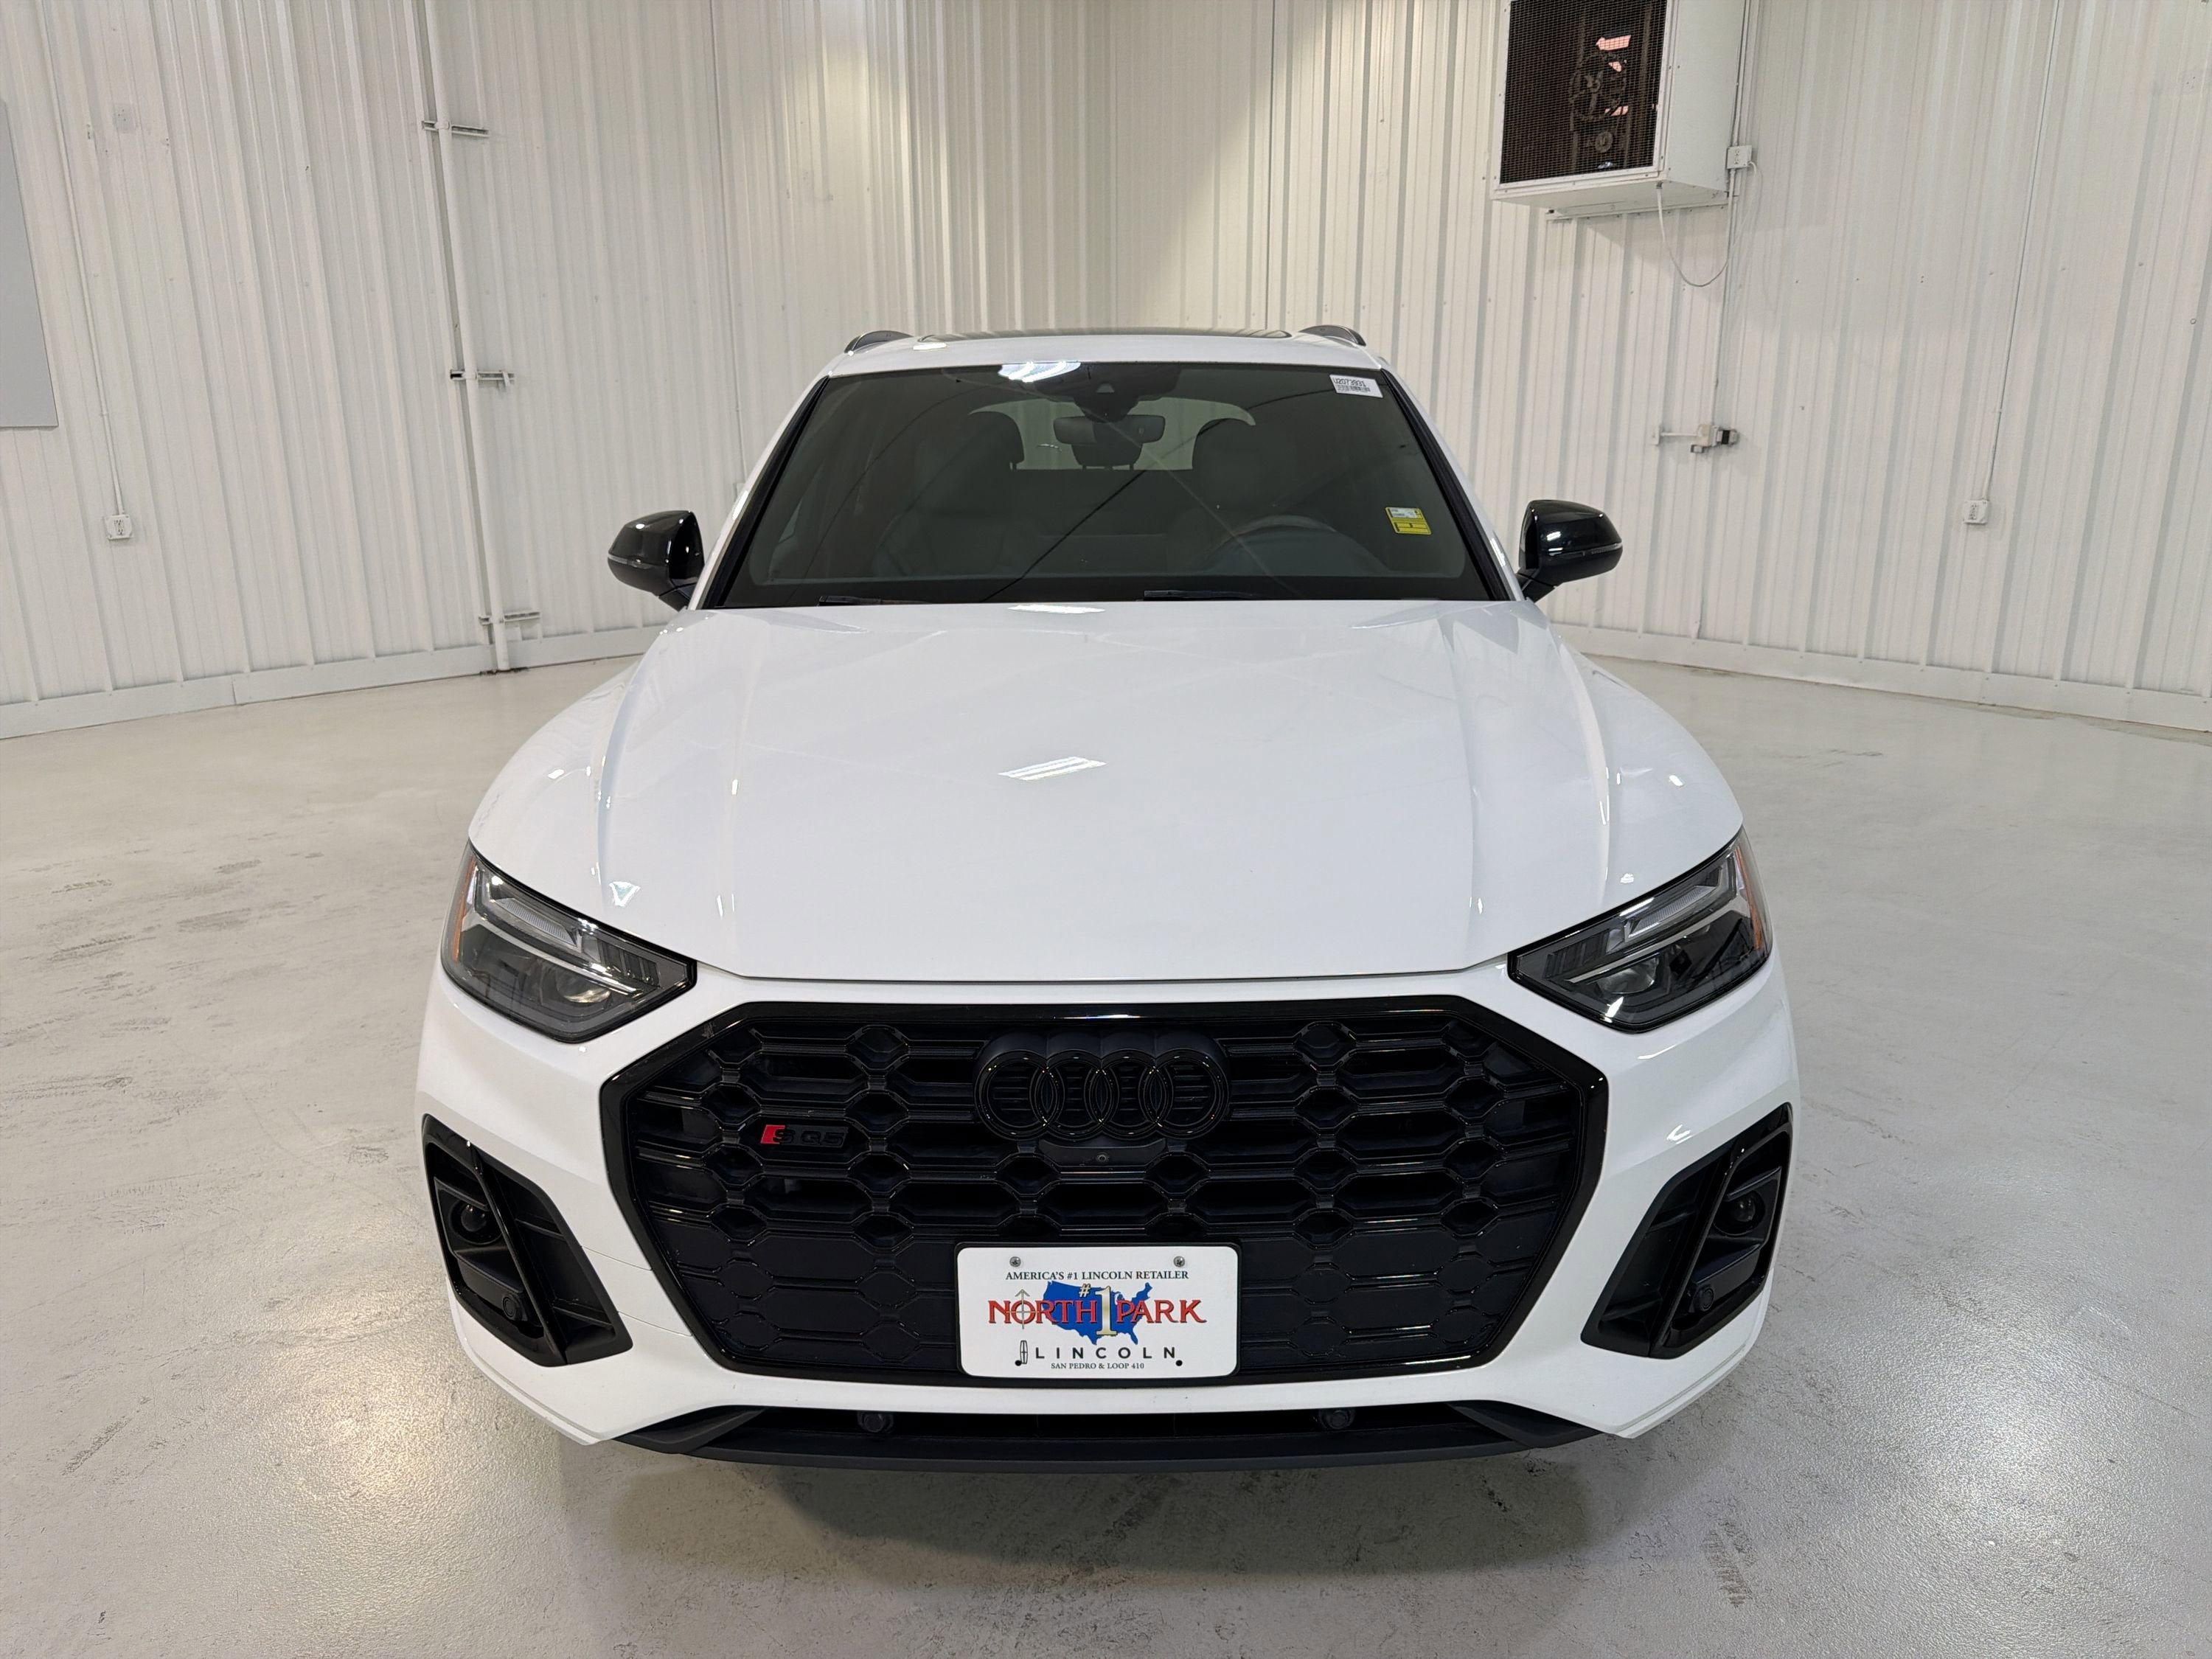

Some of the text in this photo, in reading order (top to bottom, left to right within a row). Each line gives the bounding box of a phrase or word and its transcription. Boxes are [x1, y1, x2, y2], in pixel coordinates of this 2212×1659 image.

[1005, 1270, 1189, 1280] AMERICA'S #1 LINCOLN RETAILER
[987, 1299, 1207, 1324] NORTH PARK
[1035, 1346, 1176, 1360] LINCOLN
